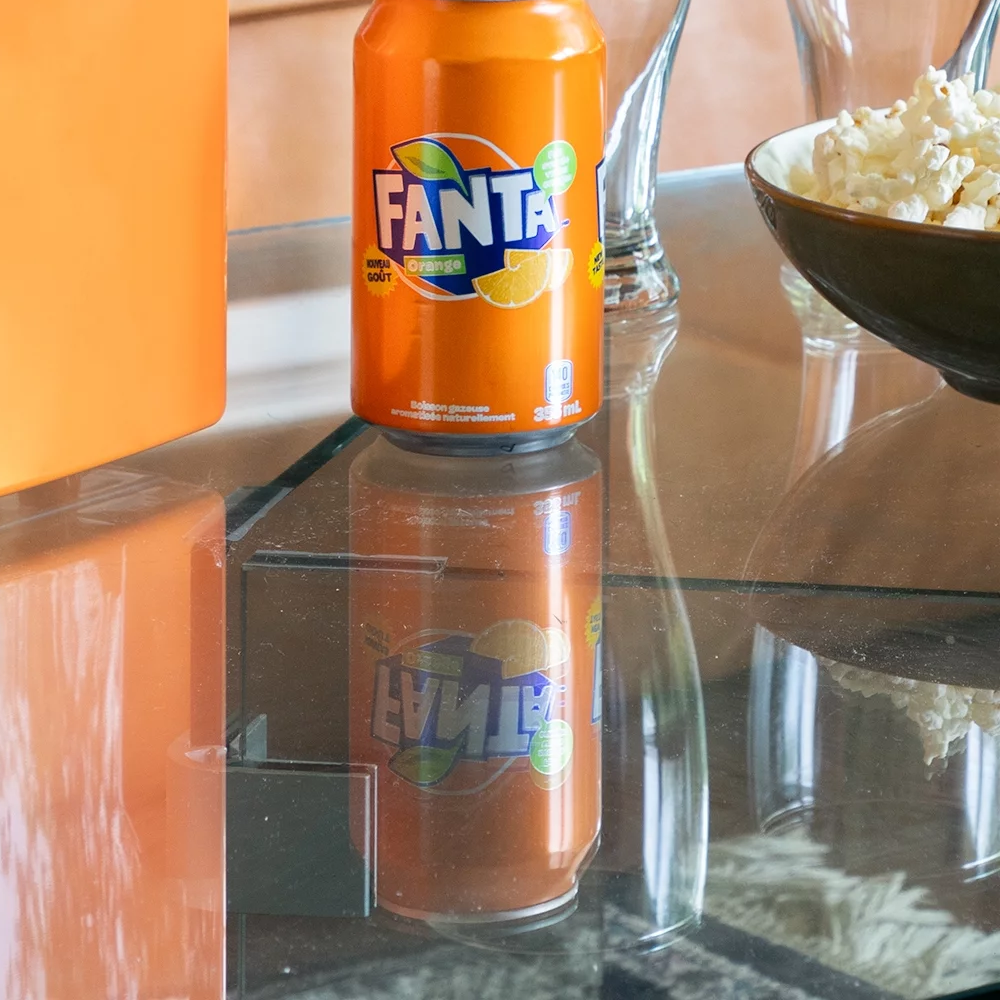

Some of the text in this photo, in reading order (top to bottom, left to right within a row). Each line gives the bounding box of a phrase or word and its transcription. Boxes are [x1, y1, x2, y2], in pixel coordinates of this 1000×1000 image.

[376, 173, 554, 251] FANTA
[366, 259, 390, 269] NOUVEAU
[407, 259, 462, 273] Orange
[367, 269, 392, 282] GOÛT
[410, 400, 490, 414] Boisson gazeuse
[563, 400, 582, 417] mL
[442, 412, 516, 422] naturellement
